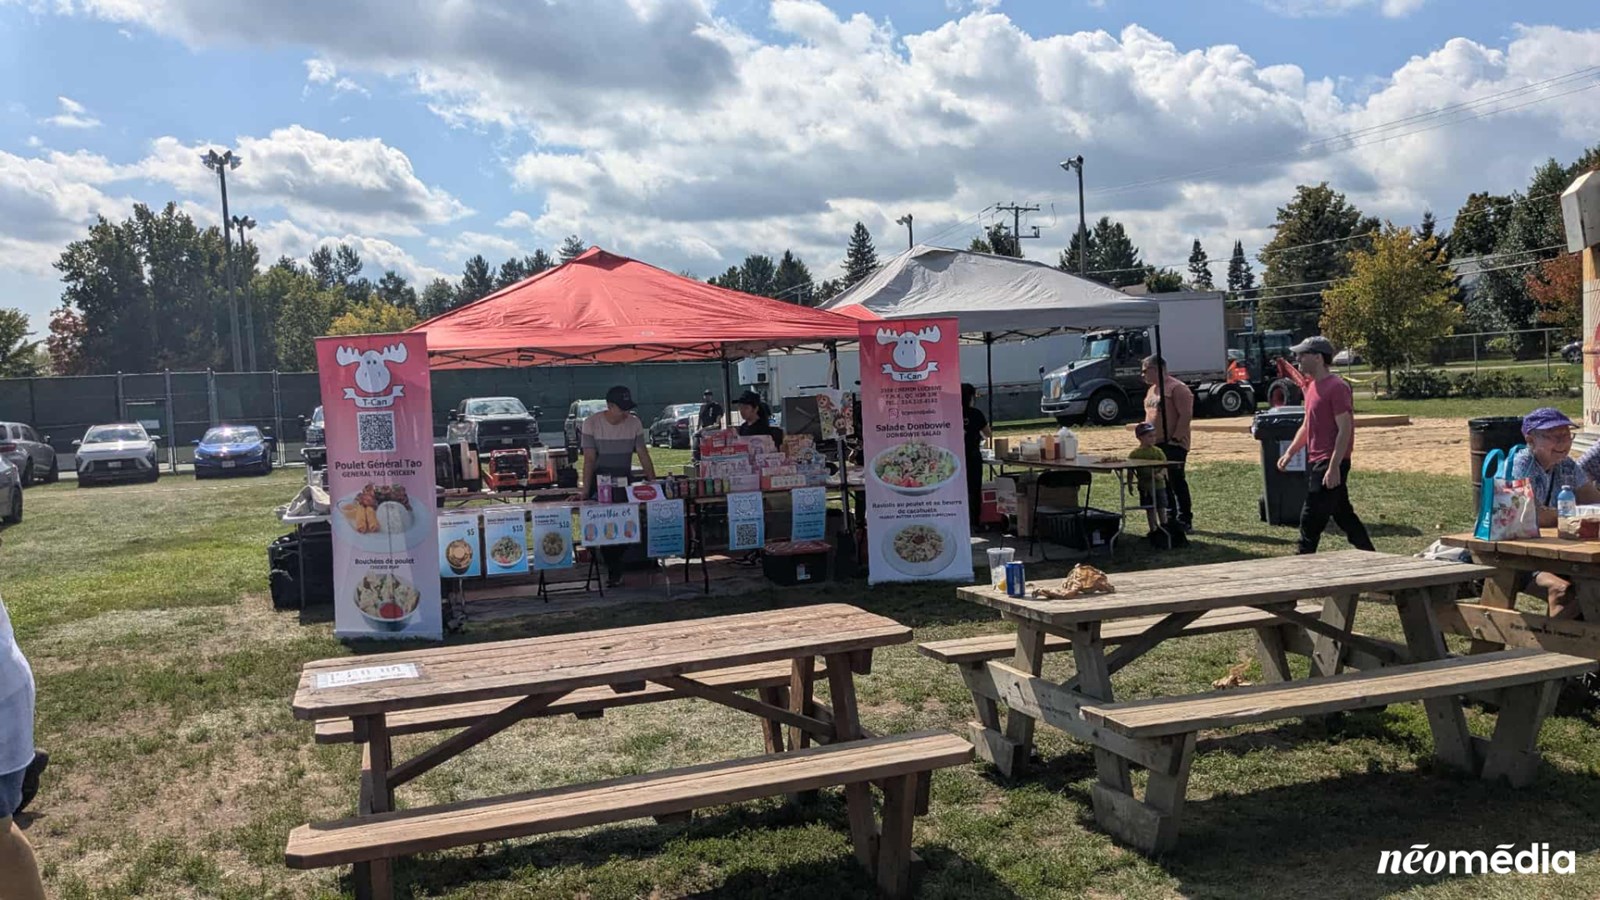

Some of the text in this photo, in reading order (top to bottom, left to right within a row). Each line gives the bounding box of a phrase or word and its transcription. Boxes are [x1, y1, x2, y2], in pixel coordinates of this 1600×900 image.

[362, 398, 387, 406] T-Can
[876, 421, 951, 432] Salade Donbowie
[335, 459, 422, 470] Poulet Général Tao
[466, 528, 475, 536] $5
[511, 525, 523, 533] $10
